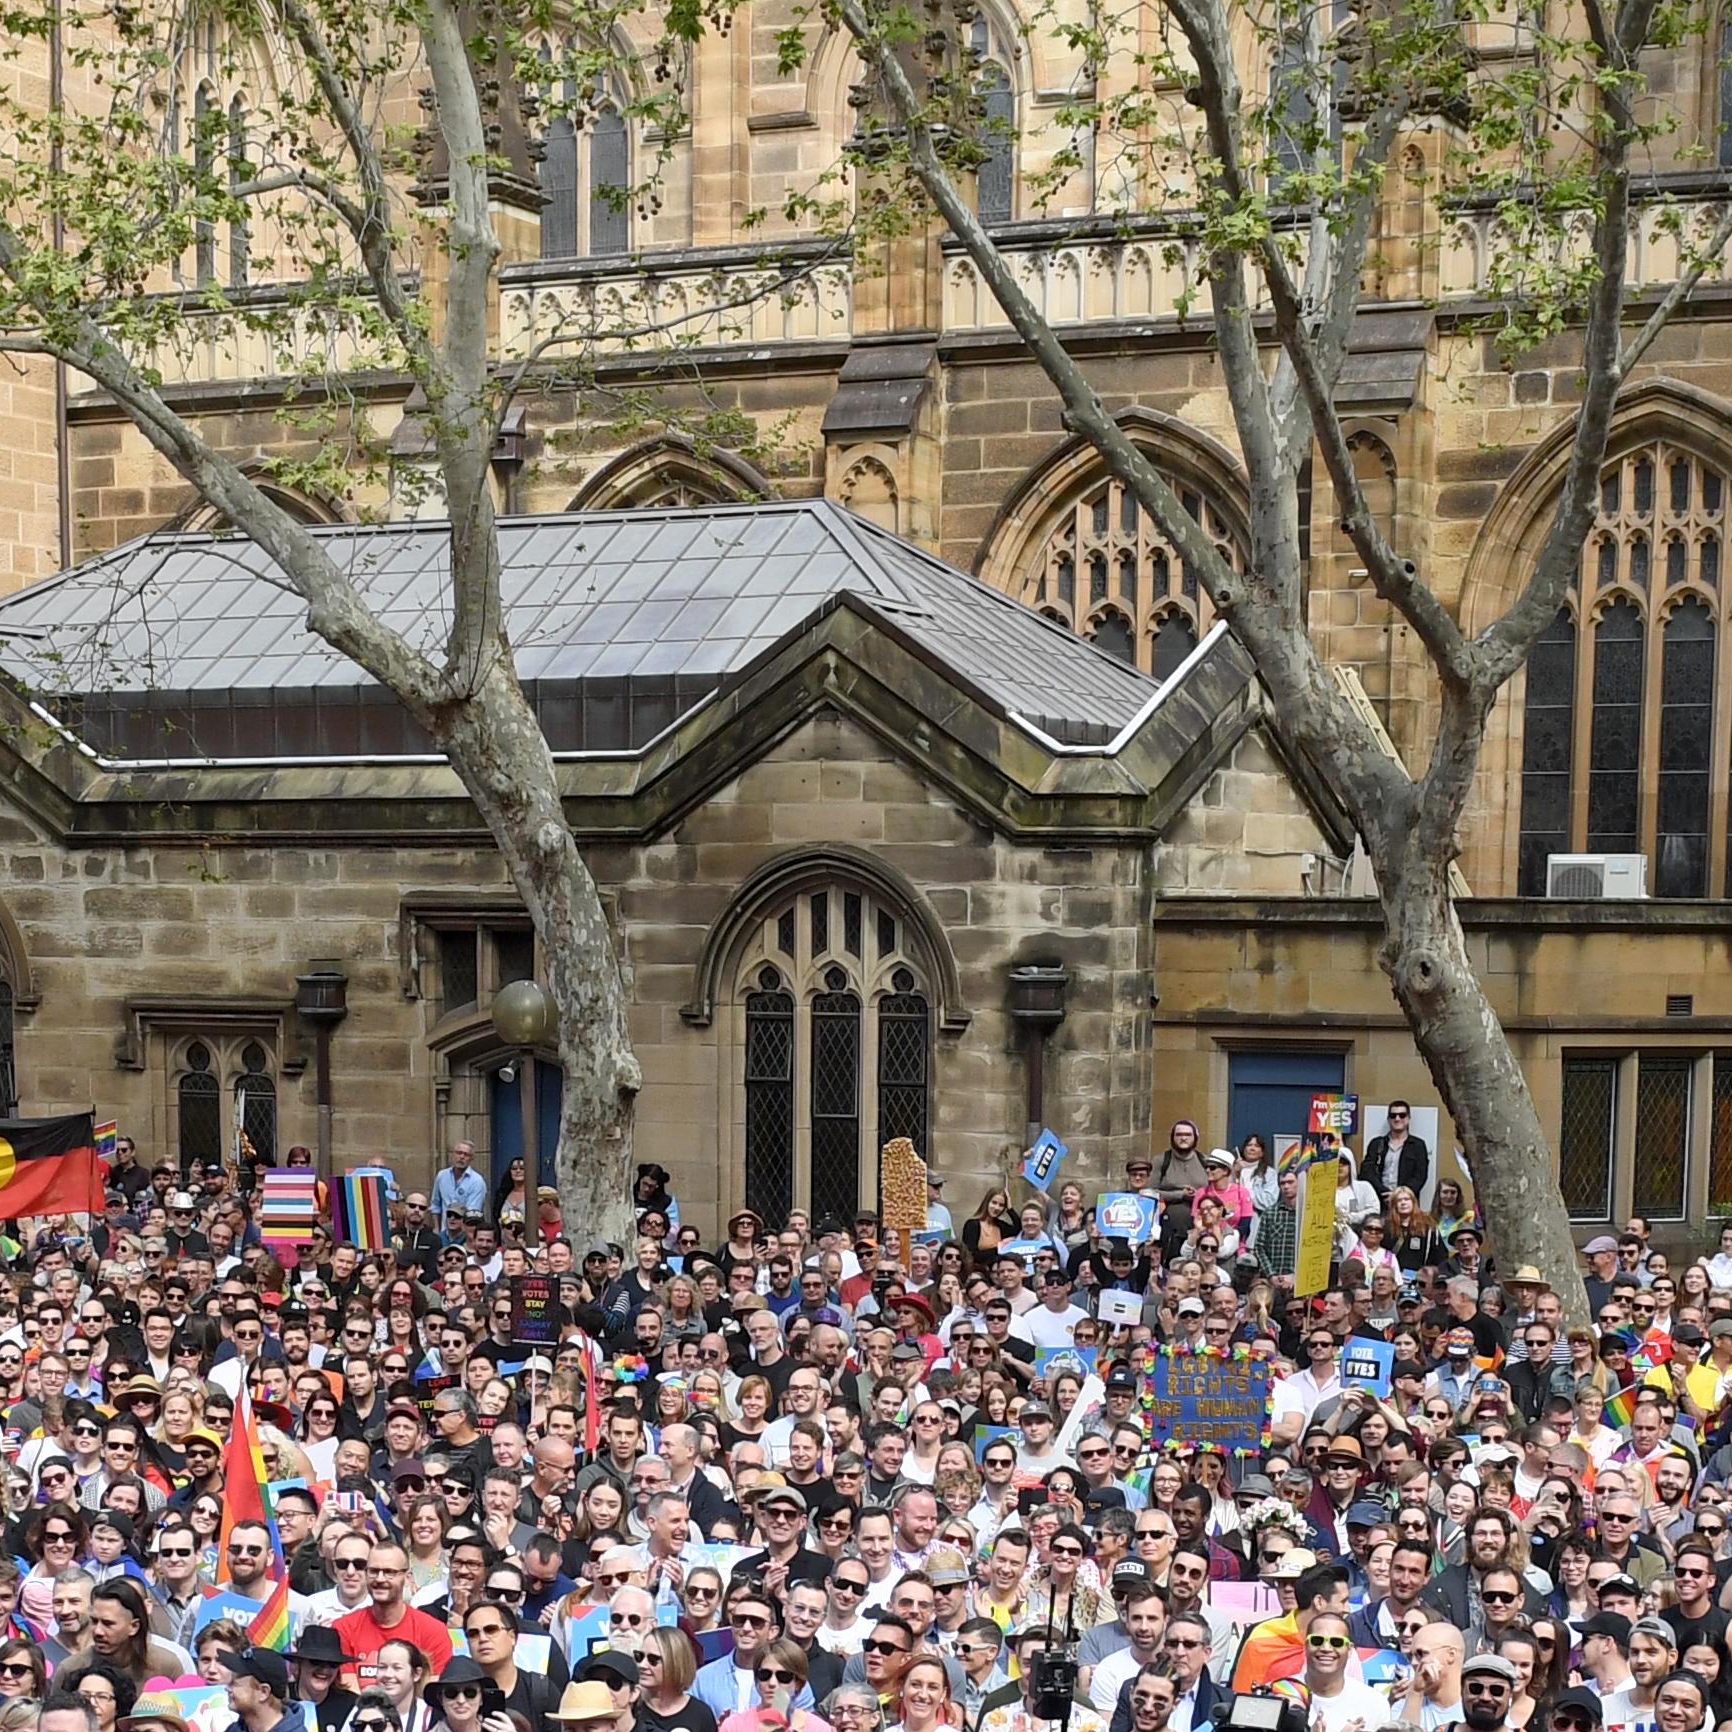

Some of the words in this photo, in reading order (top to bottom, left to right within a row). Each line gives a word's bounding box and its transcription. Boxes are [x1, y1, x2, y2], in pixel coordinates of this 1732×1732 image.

[1316, 1112, 1352, 1128] YES
[525, 1299, 546, 1308] STAY
[1351, 1347, 1374, 1359] VOTE
[1353, 1361, 1376, 1377] YES
[1167, 1375, 1250, 1396] RIGHTS
[1151, 1399, 1182, 1417] ARE
[1196, 1399, 1259, 1417] HUMAN
[1172, 1421, 1258, 1440] RIGHTS
[222, 1606, 258, 1627] VOT
